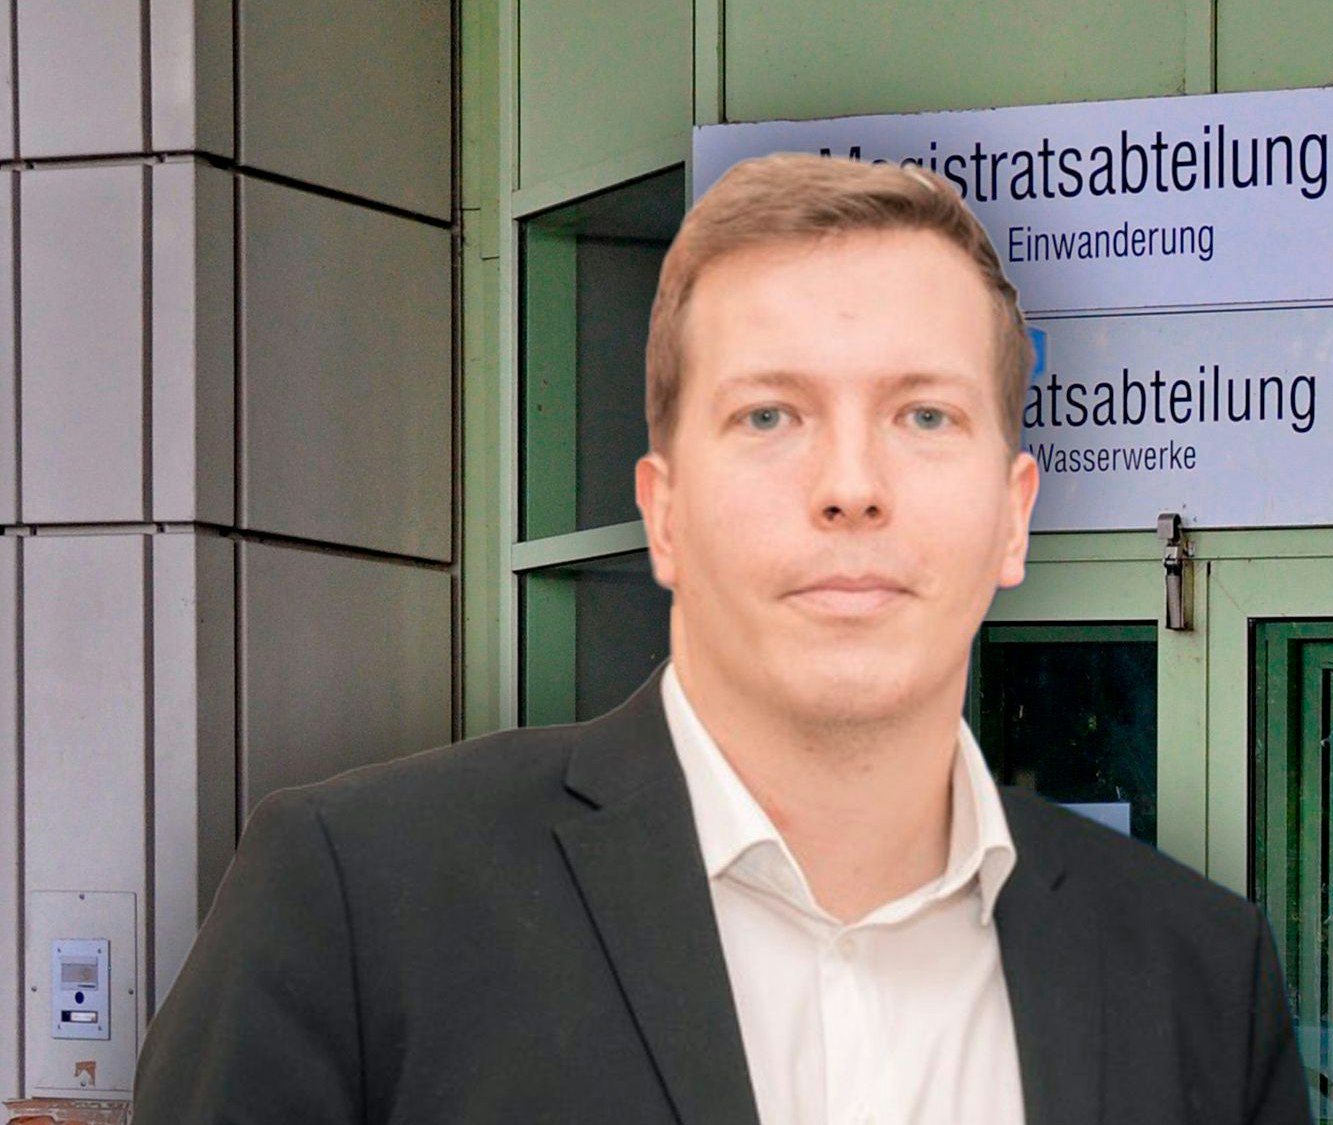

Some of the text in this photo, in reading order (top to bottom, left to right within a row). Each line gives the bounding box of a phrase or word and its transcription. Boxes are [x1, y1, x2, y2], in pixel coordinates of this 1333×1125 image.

[820, 124, 1327, 200] istratsabteilung
[1008, 221, 1214, 262] Einwanderung
[1029, 440, 1197, 473] Wasserwerke
